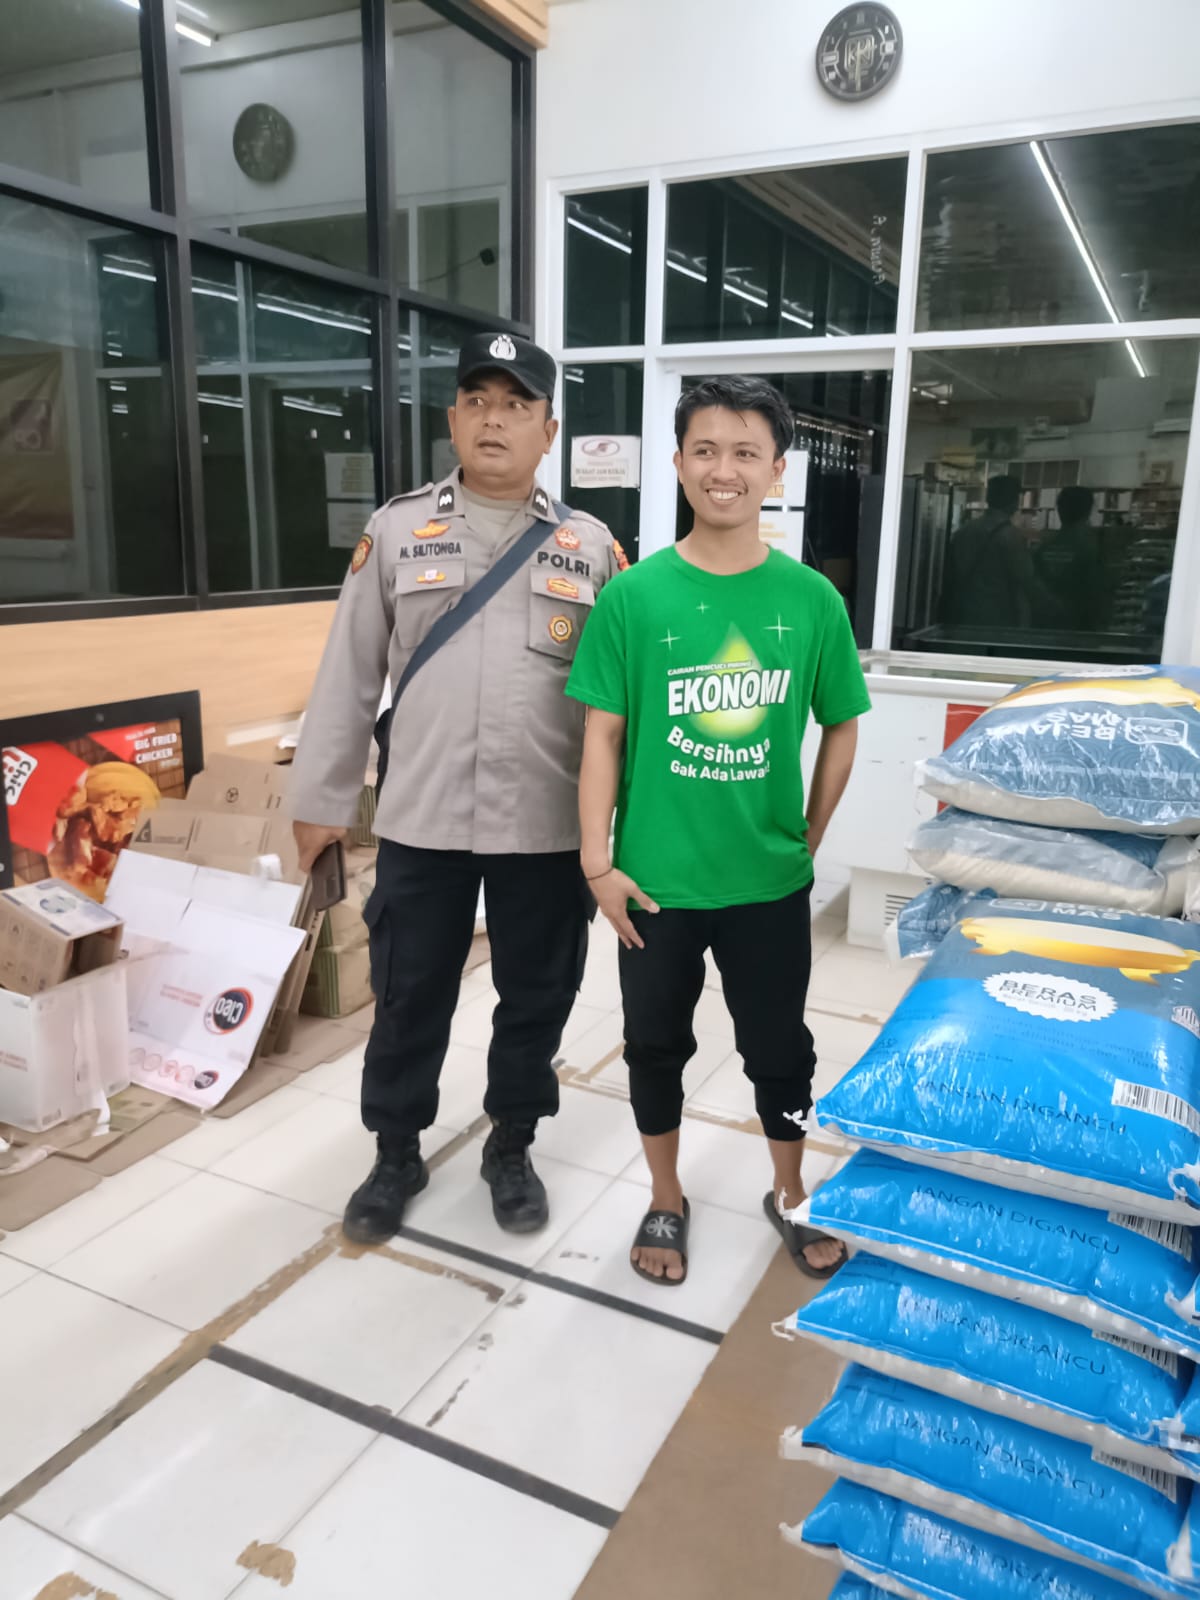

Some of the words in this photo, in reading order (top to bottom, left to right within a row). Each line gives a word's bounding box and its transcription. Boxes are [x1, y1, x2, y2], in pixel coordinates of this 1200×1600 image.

[537, 551, 590, 577] POLRI
[668, 669, 791, 716] EKONOMI
[670, 760, 697, 778] Gak
[700, 765, 728, 781] Ada
[999, 986, 1097, 1013] PREMIUM
[1002, 979, 1097, 1005] BERAS
[215, 997, 244, 1025] Cleo
[1010, 1210, 1120, 1255] DIGANCU
